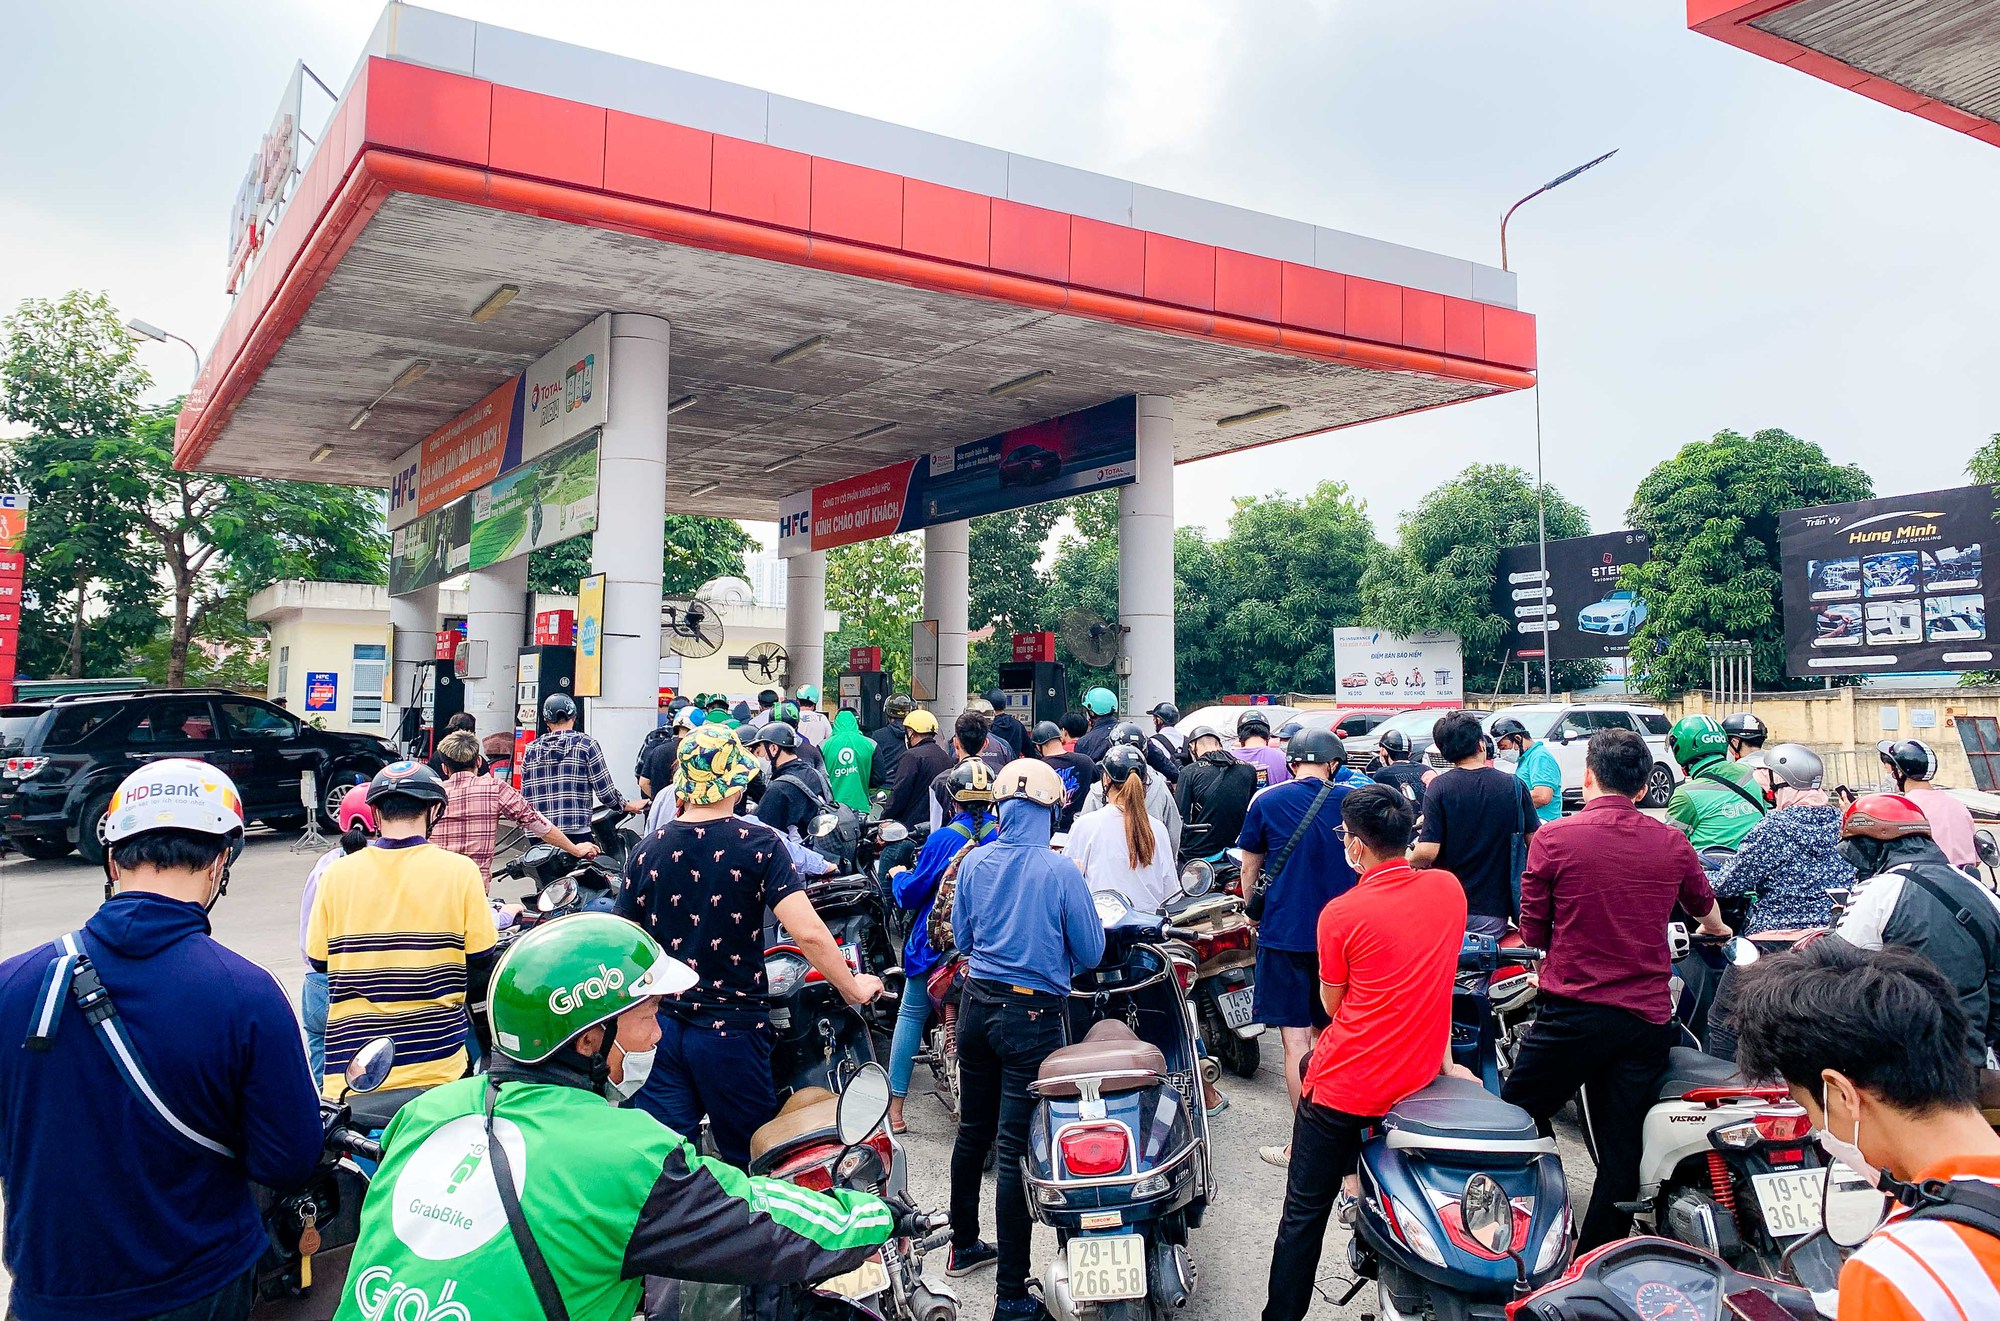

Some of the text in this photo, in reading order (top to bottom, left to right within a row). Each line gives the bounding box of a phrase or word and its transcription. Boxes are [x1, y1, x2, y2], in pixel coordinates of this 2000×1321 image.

[541, 380, 562, 401] TOTAL
[1105, 467, 1124, 476] TOTAL
[391, 463, 417, 511] HFC
[822, 496, 834, 508] CÔNG
[834, 496, 840, 505] TY
[880, 482, 890, 492] HFC
[780, 510, 809, 538] HFC
[814, 495, 902, 536] KÍNH CHÀO QUÝ KHÁCH
[1849, 523, 1937, 544] Hưng Minh
[1909, 535, 1942, 543] DETAILING
[1701, 733, 1726, 744] Grab
[834, 766, 858, 778] gojek
[126, 783, 199, 805] HDBank
[1722, 801, 1754, 819] Gra
[549, 963, 625, 1015] Grab
[1226, 989, 1253, 1009] 14-B
[1669, 1115, 1707, 1123] VISION
[1768, 1174, 1822, 1203] 19-C1
[409, 1198, 473, 1230] GrabBike
[1079, 1239, 1131, 1268] 29-L1
[354, 1265, 472, 1321] Grab
[1074, 1268, 1140, 1296] 266.58
